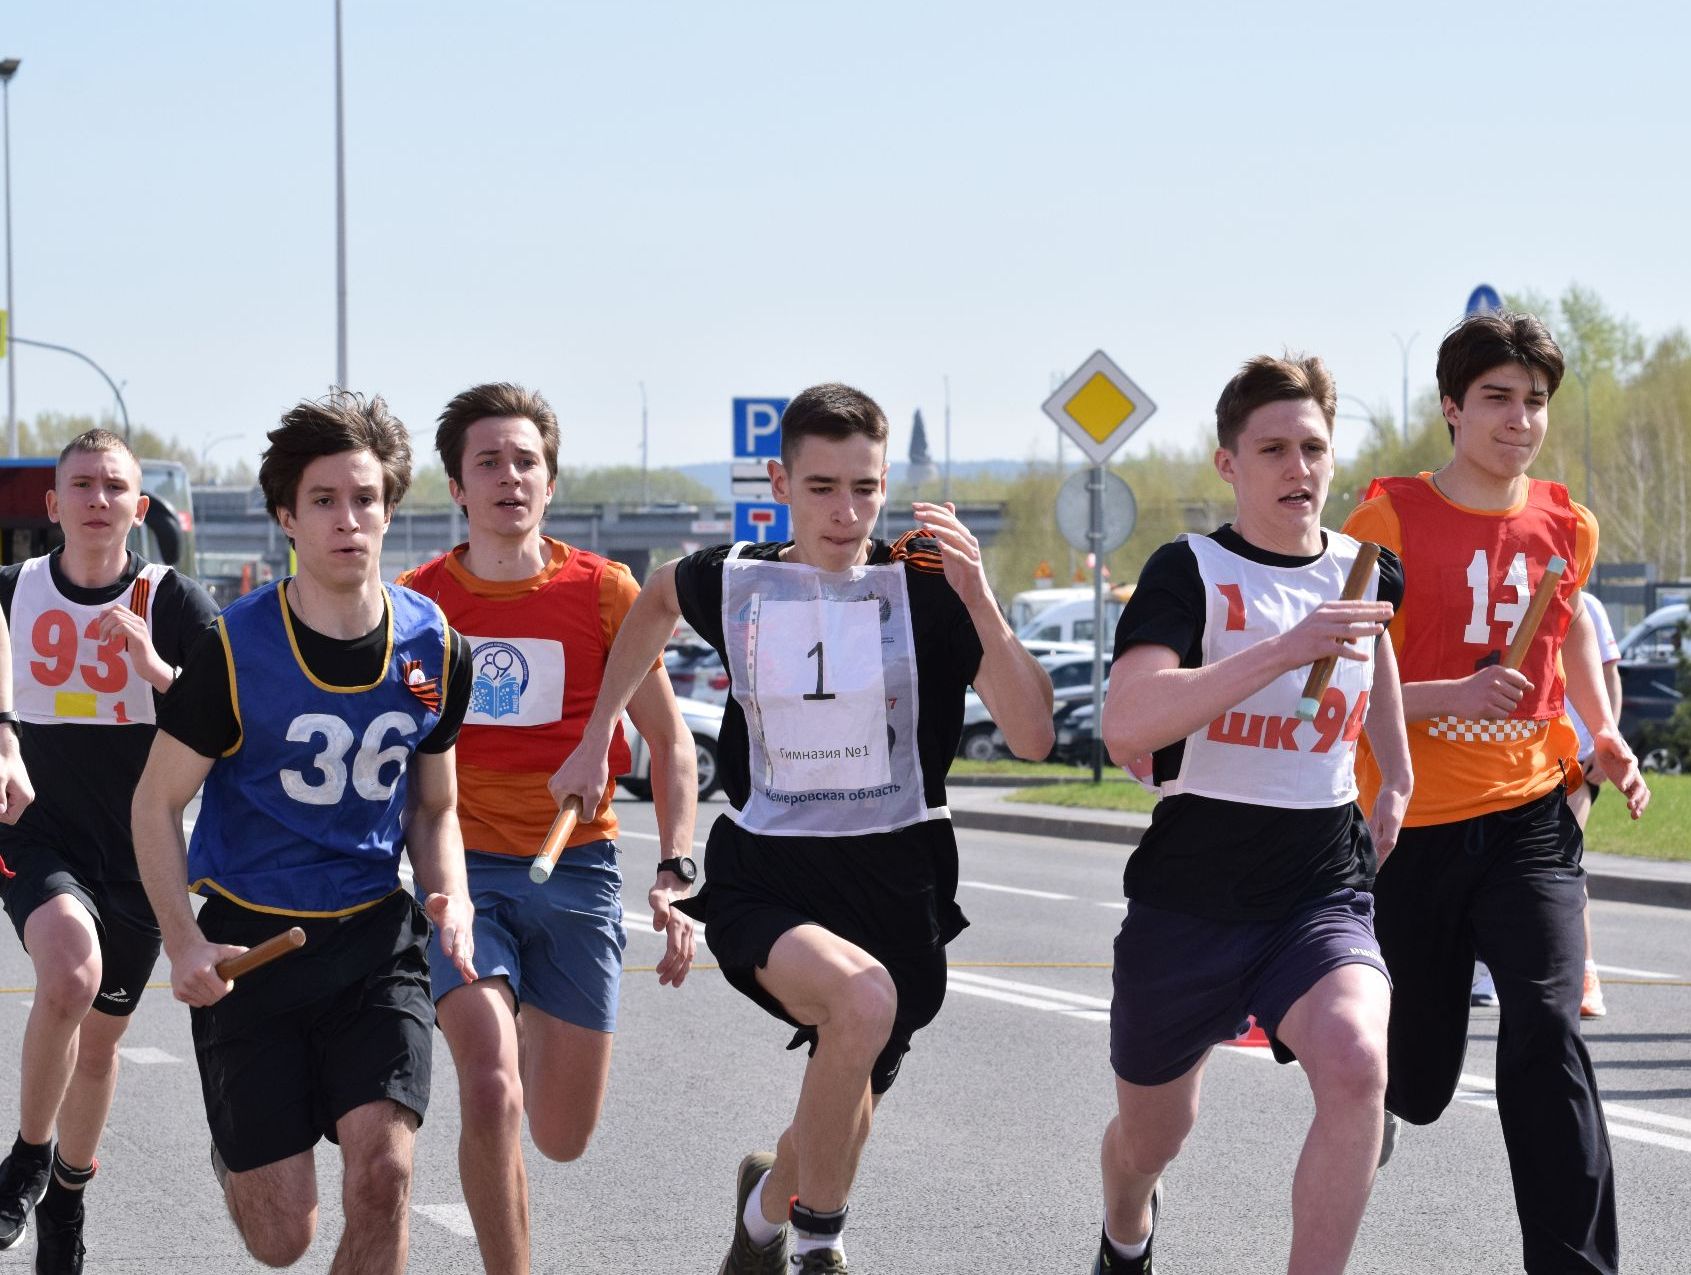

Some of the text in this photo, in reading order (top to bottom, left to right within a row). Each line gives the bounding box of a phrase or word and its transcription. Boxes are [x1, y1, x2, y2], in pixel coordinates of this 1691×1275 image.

[746, 403, 779, 453] P
[30, 609, 128, 693] 93
[803, 641, 835, 701] 1
[113, 701, 132, 722] 1
[280, 712, 418, 807] 36
[779, 744, 869, 759] Гимназия №1
[766, 783, 901, 806] Кемеровская область
